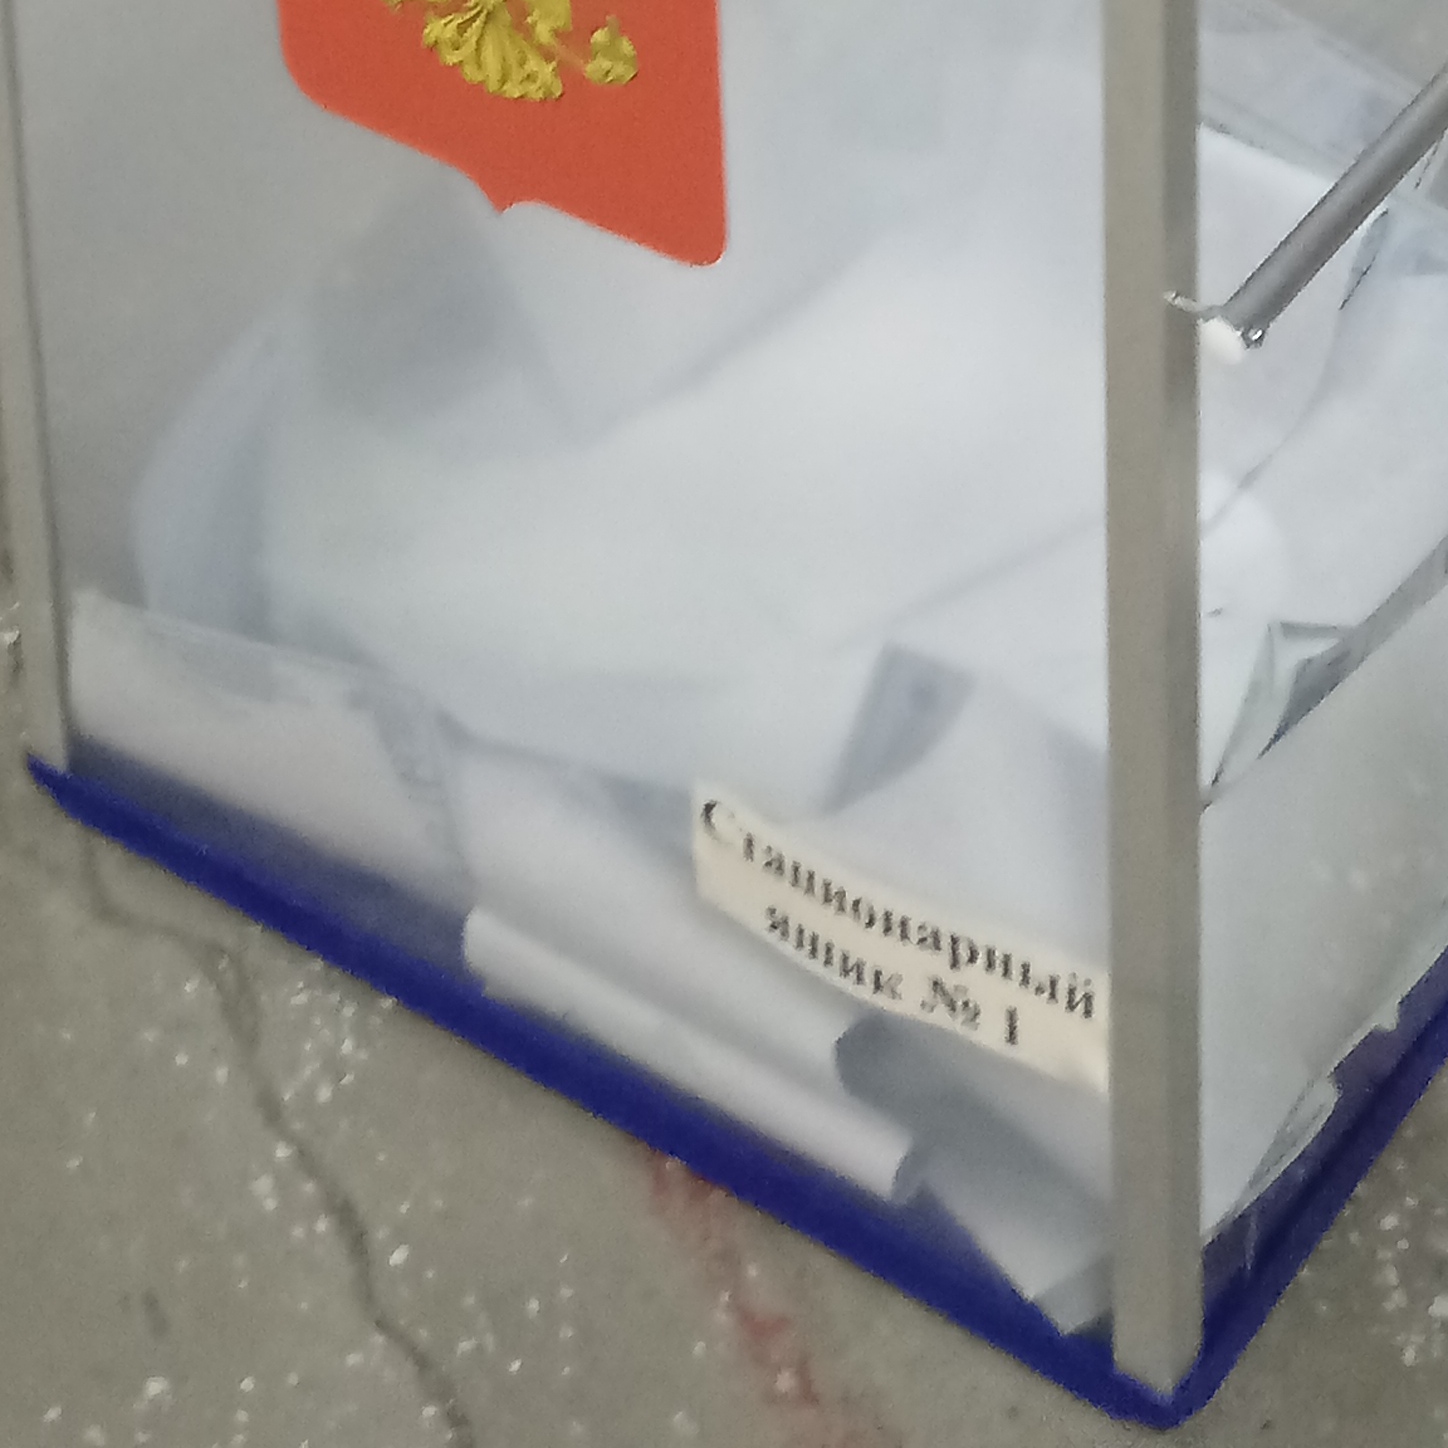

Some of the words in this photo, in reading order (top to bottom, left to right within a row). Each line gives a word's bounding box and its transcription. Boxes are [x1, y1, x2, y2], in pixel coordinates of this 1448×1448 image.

[701, 799, 1096, 1020] Стационарный
[764, 905, 903, 1001] ящик
[919, 975, 982, 1031] №
